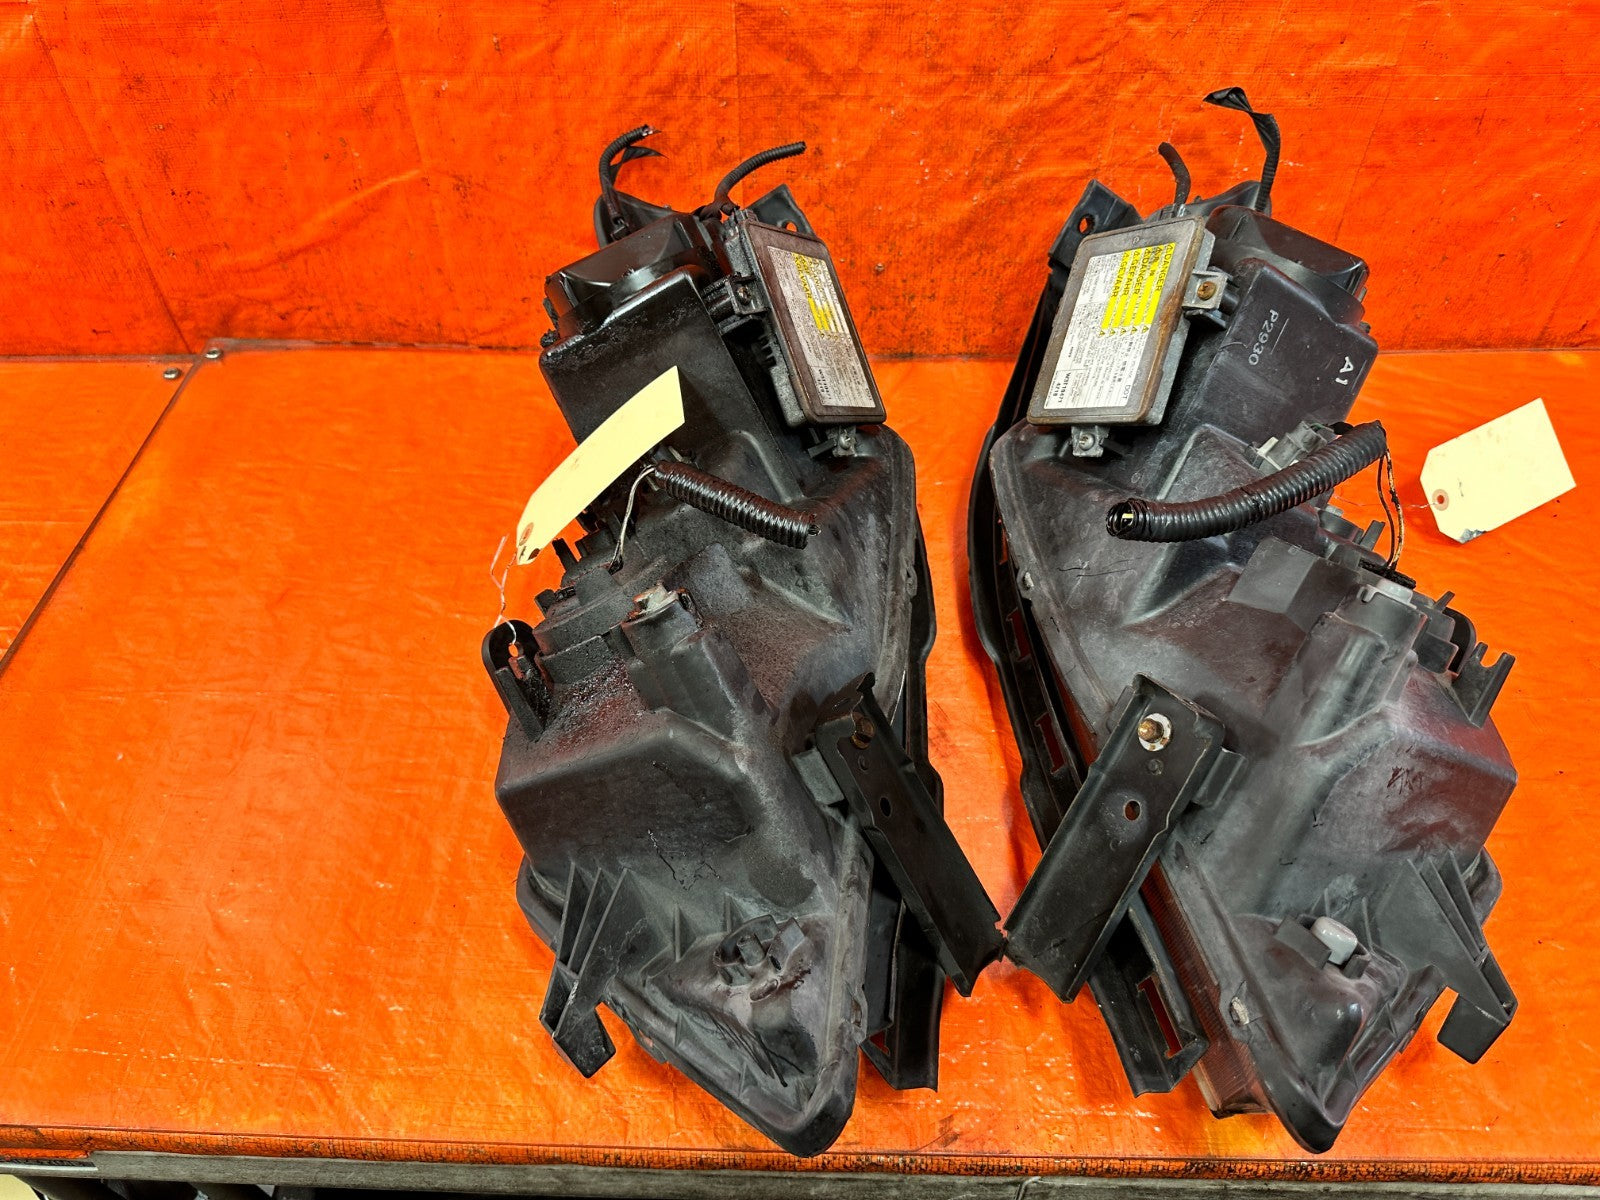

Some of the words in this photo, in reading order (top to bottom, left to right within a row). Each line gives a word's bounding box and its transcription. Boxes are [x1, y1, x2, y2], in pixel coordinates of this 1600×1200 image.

[1111, 260, 1128, 298] GEVAAR
[1121, 258, 1138, 296] GEFAHR
[1133, 254, 1149, 295] DANGER
[1155, 250, 1172, 292] DANGER
[1248, 309, 1279, 366] P2930
[1121, 384, 1132, 400] DOT
